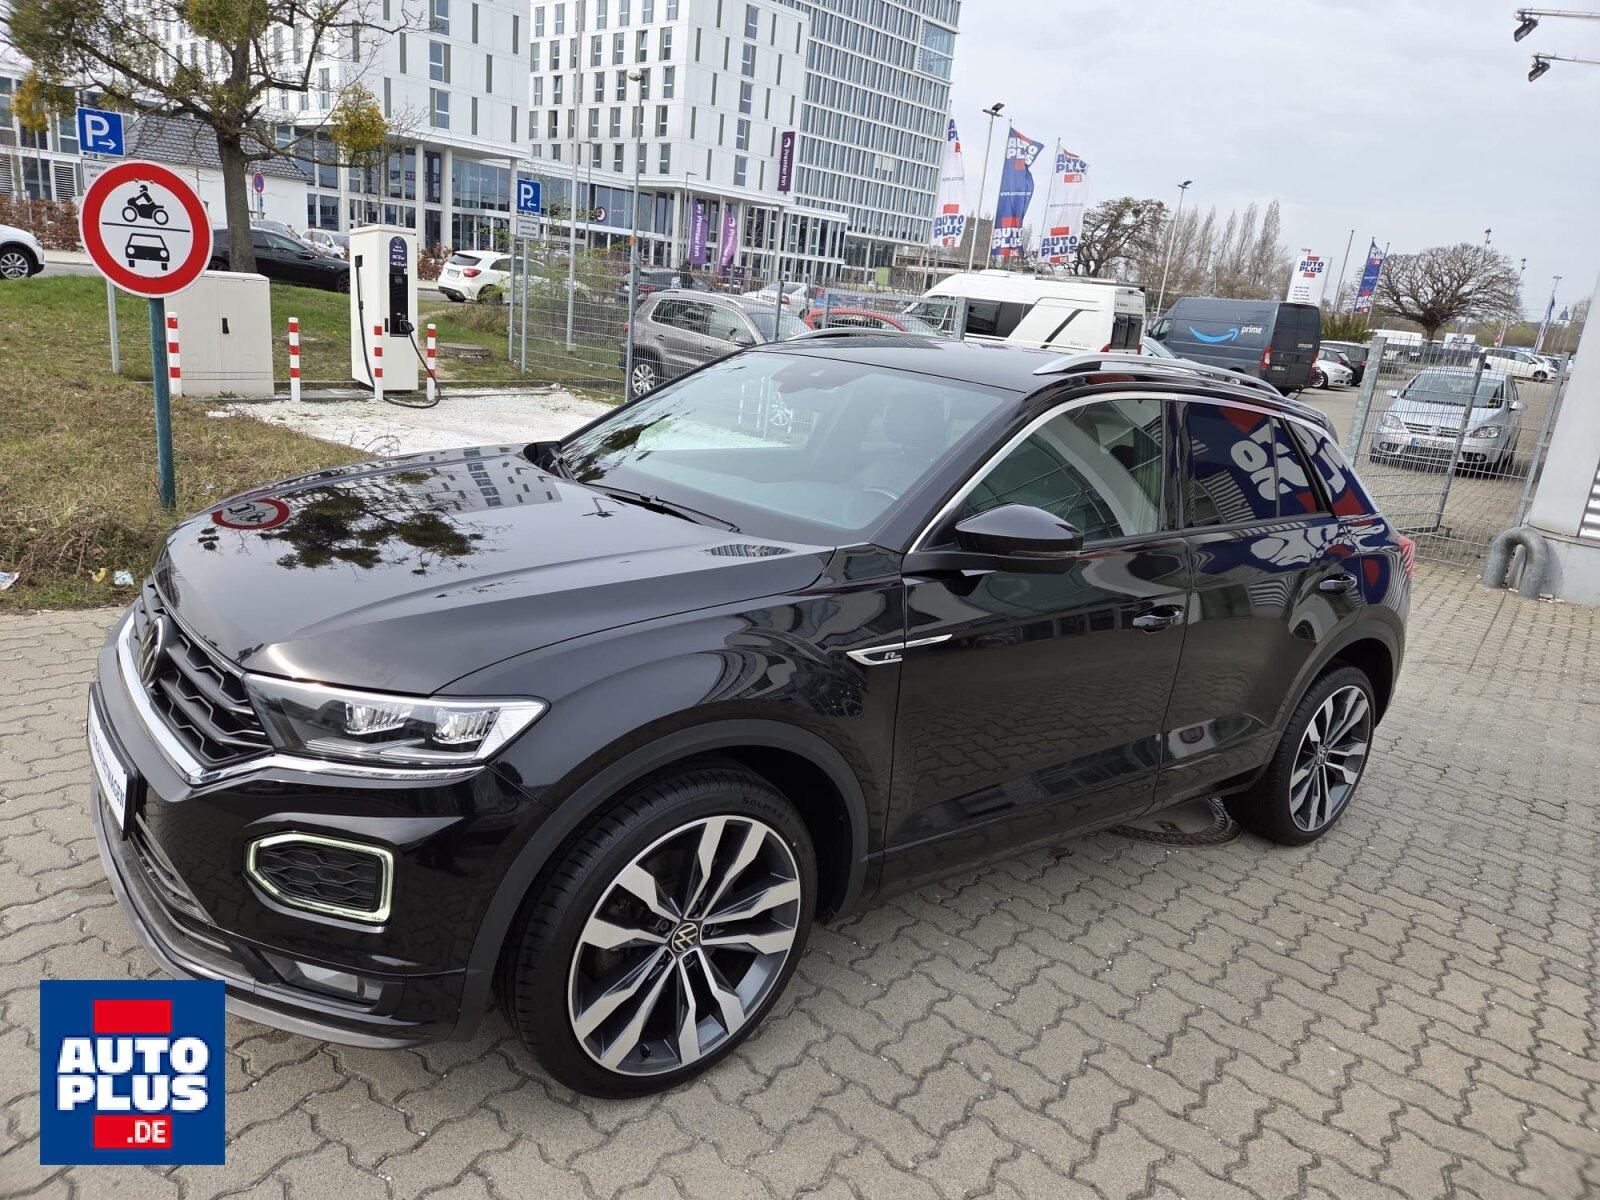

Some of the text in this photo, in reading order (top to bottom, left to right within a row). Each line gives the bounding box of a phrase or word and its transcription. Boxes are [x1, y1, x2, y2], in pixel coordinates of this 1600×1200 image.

[85, 114, 110, 147] P
[1007, 137, 1038, 155] AUO
[781, 148, 790, 176] Premier
[1006, 148, 1035, 165] PLS
[1055, 163, 1087, 175] PLS
[520, 183, 534, 207] P
[934, 214, 965, 228] AUTO
[693, 215, 704, 257] Premier Inn
[933, 225, 962, 239] PLUS
[1041, 235, 1078, 248] AUTO
[1041, 245, 1077, 257] PLUS
[1300, 260, 1324, 268] AUTO
[1241, 324, 1263, 335] prime
